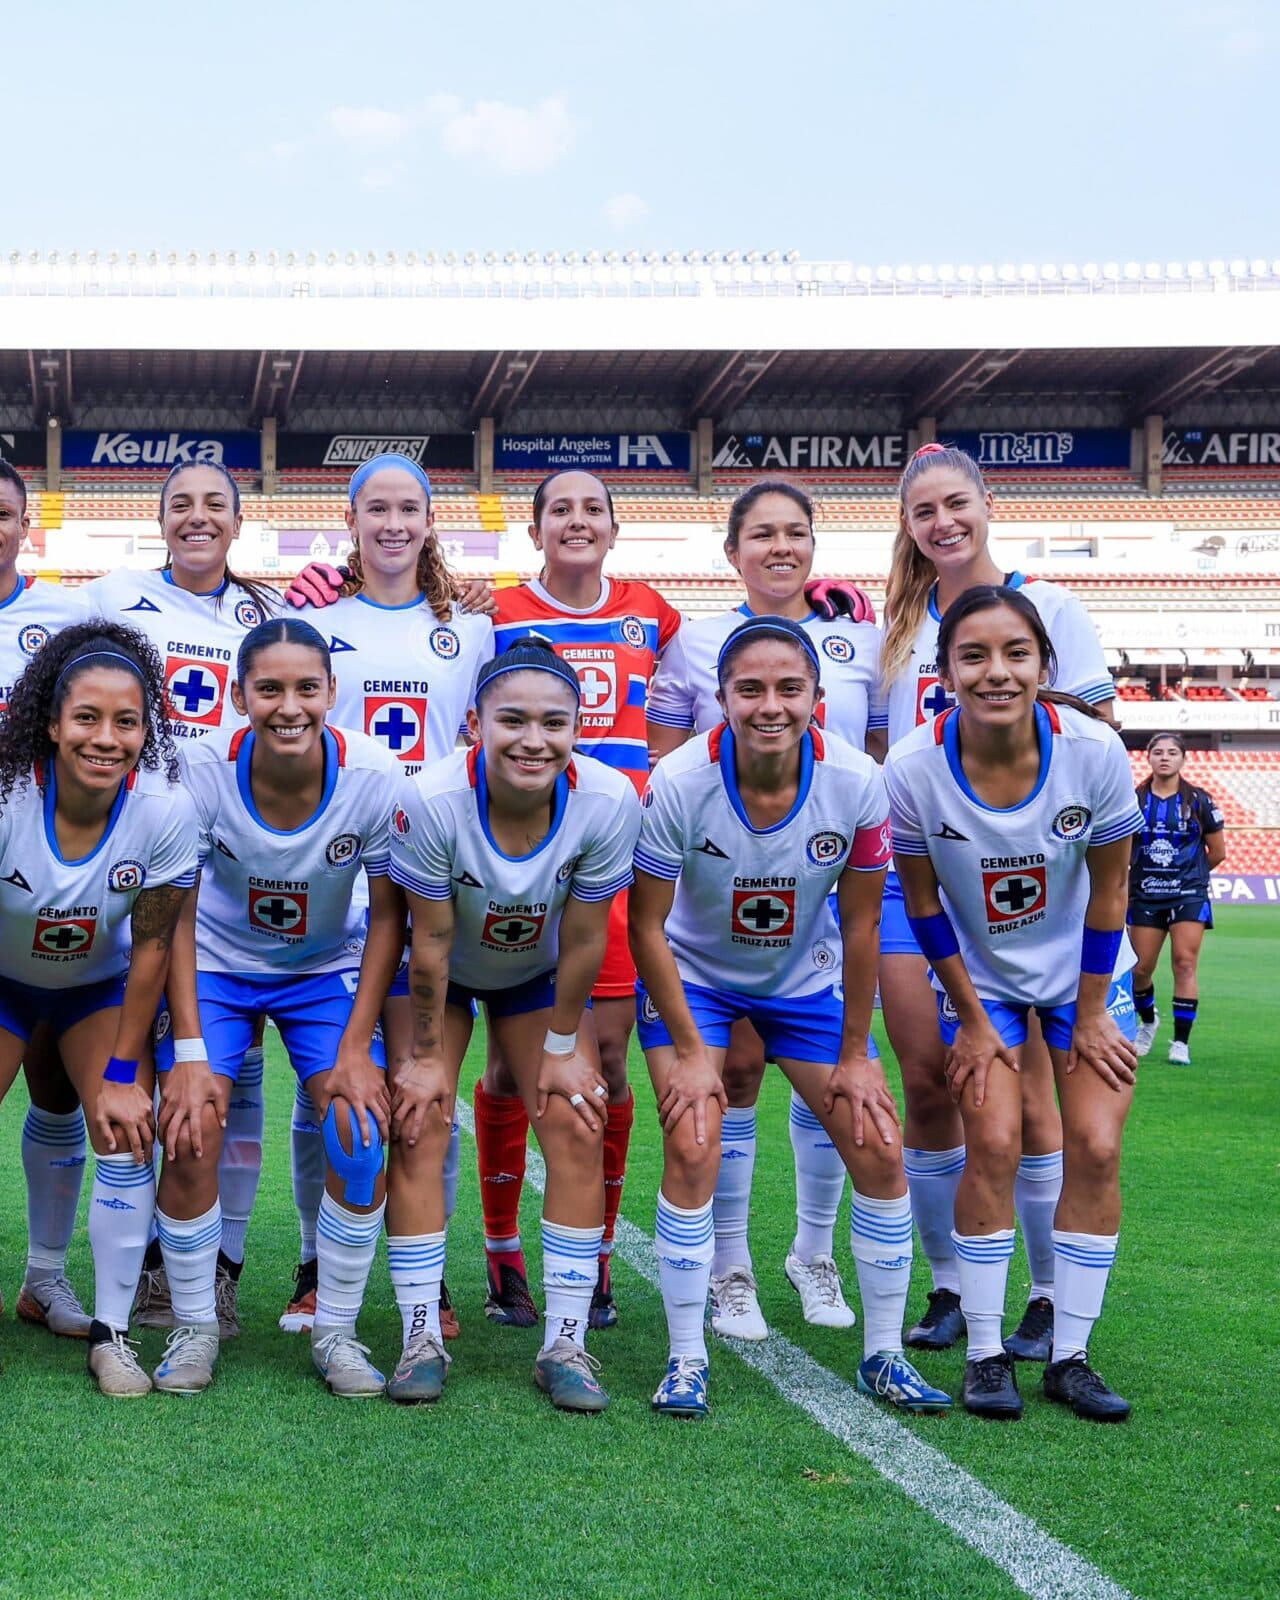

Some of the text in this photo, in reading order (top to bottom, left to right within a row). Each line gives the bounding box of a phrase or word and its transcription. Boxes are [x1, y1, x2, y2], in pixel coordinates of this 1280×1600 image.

[91, 433, 224, 463] Keuka
[331, 438, 421, 461] SNICKERS
[503, 437, 612, 456] Hospital Angeles
[761, 436, 903, 467] AFIRME
[548, 454, 612, 464] HEALTH SYSTEM
[167, 641, 232, 661] CEMENTO
[563, 649, 616, 660] CEMENTO
[364, 680, 428, 694] CEMENTO
[981, 853, 1045, 869] CEMENTO
[248, 876, 309, 891] CEMENTO
[733, 877, 796, 888] CEMENTO
[38, 906, 98, 919] CEMENTO
[488, 900, 547, 914] CEMENTO
[988, 911, 1046, 935] CRUZ AZUL
[480, 941, 538, 953] CRUZ AZUL
[731, 935, 792, 948] CRUZ AZUL
[31, 952, 89, 962] CRUZ AZUL
